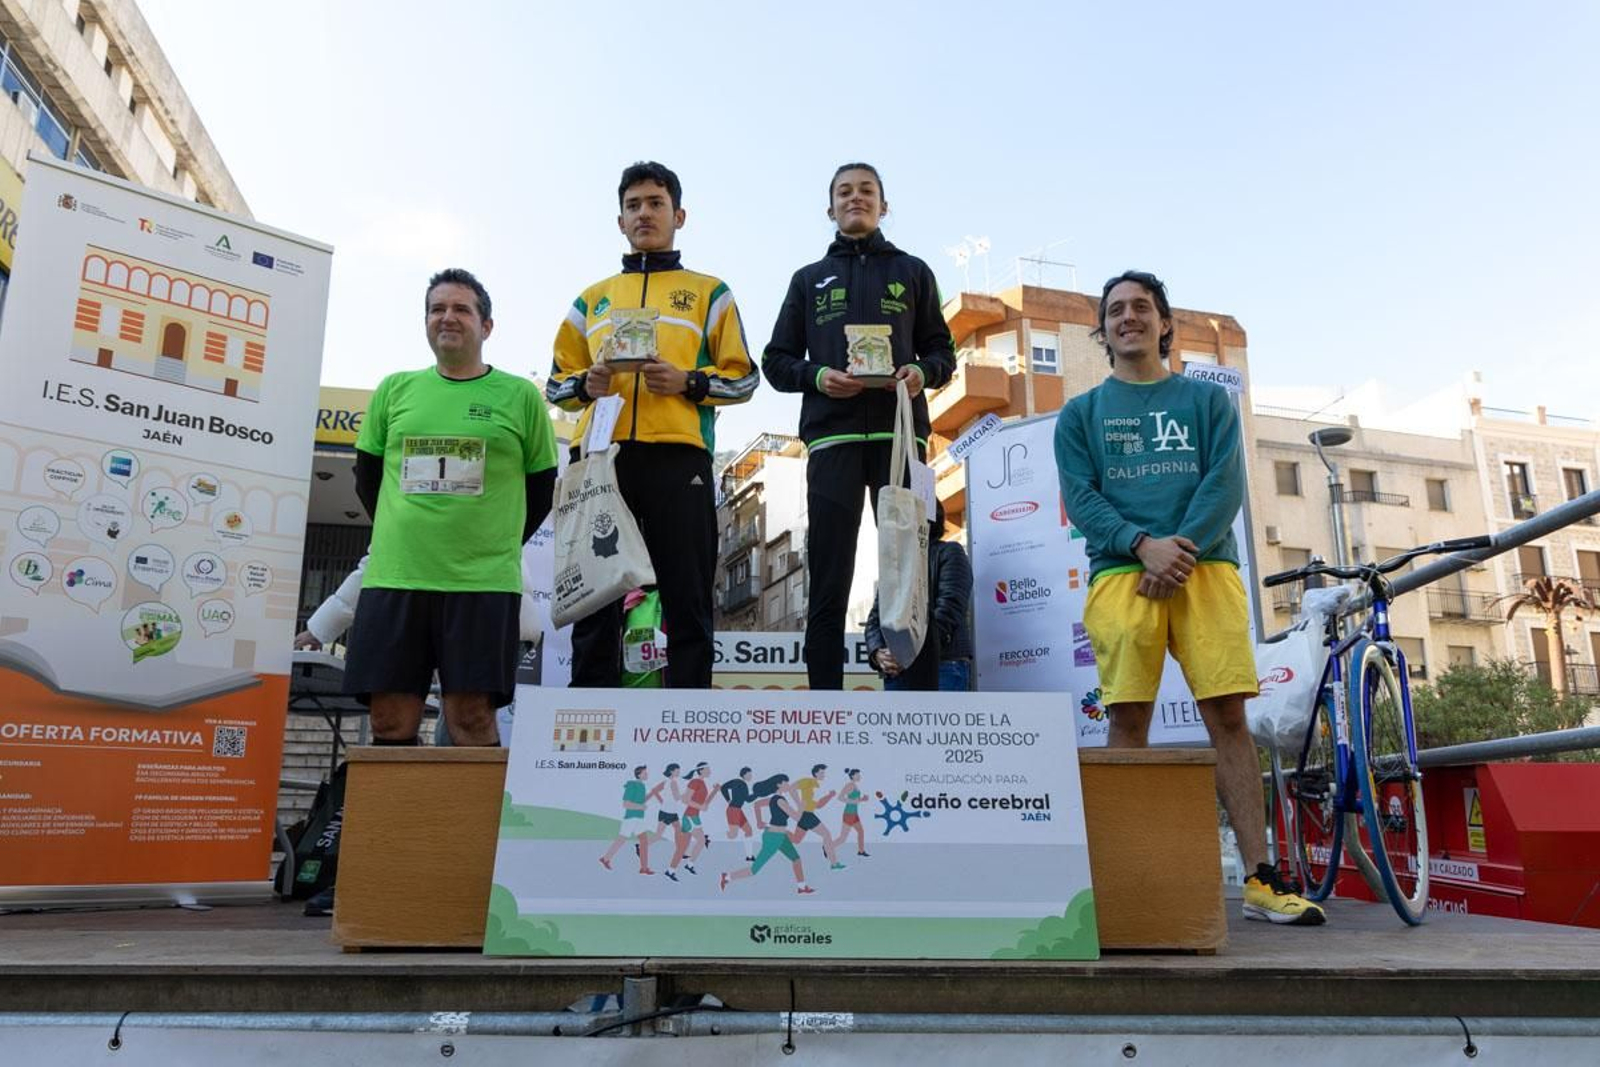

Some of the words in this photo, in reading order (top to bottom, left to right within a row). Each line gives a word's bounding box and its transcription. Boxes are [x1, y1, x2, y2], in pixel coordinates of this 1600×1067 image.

[42, 379, 100, 409] I.E.S.
[104, 393, 150, 419] San
[152, 404, 204, 431] Juan
[209, 415, 274, 445] Bosco
[1104, 418, 1141, 426] INDIGO
[142, 428, 184, 446] JAÉN
[951, 417, 998, 457] ¡GRACIAS!
[1148, 411, 1196, 452] LA
[438, 457, 446, 480] 1
[1107, 461, 1199, 480] CALIFORNIA
[1009, 577, 1037, 592] Bello
[1010, 586, 1051, 602] Cabello
[734, 641, 785, 664] San
[999, 647, 1050, 661] FERCOLOR
[661, 710, 680, 724] EL
[684, 710, 742, 724] BOSCO
[781, 710, 852, 725] MUEVE"
[856, 712, 893, 726] CON
[897, 712, 961, 727] MOTIVO
[965, 713, 986, 727] DE
[990, 713, 1011, 727] LA
[0, 723, 84, 741] OFERTA
[89, 727, 203, 746] FORMATIVA
[633, 727, 650, 743] IV
[656, 728, 740, 743] CARRERA
[746, 728, 831, 744] POPULAR
[837, 731, 874, 745] I.E.S.
[881, 731, 922, 746] "SAN
[926, 732, 974, 746] JUAN
[977, 732, 1040, 746] BOSCO"
[944, 749, 984, 764] 2025
[558, 761, 575, 770] San
[575, 761, 597, 771] Juan
[598, 761, 627, 771] Bosco
[905, 773, 993, 786] RECAUDACIÓN
[995, 774, 1028, 786] PARA
[911, 792, 961, 810] daño
[968, 793, 1050, 811] cerebral
[1021, 811, 1051, 822] JAÉN
[1440, 863, 1474, 877] CALZADO
[773, 932, 833, 944] morales
